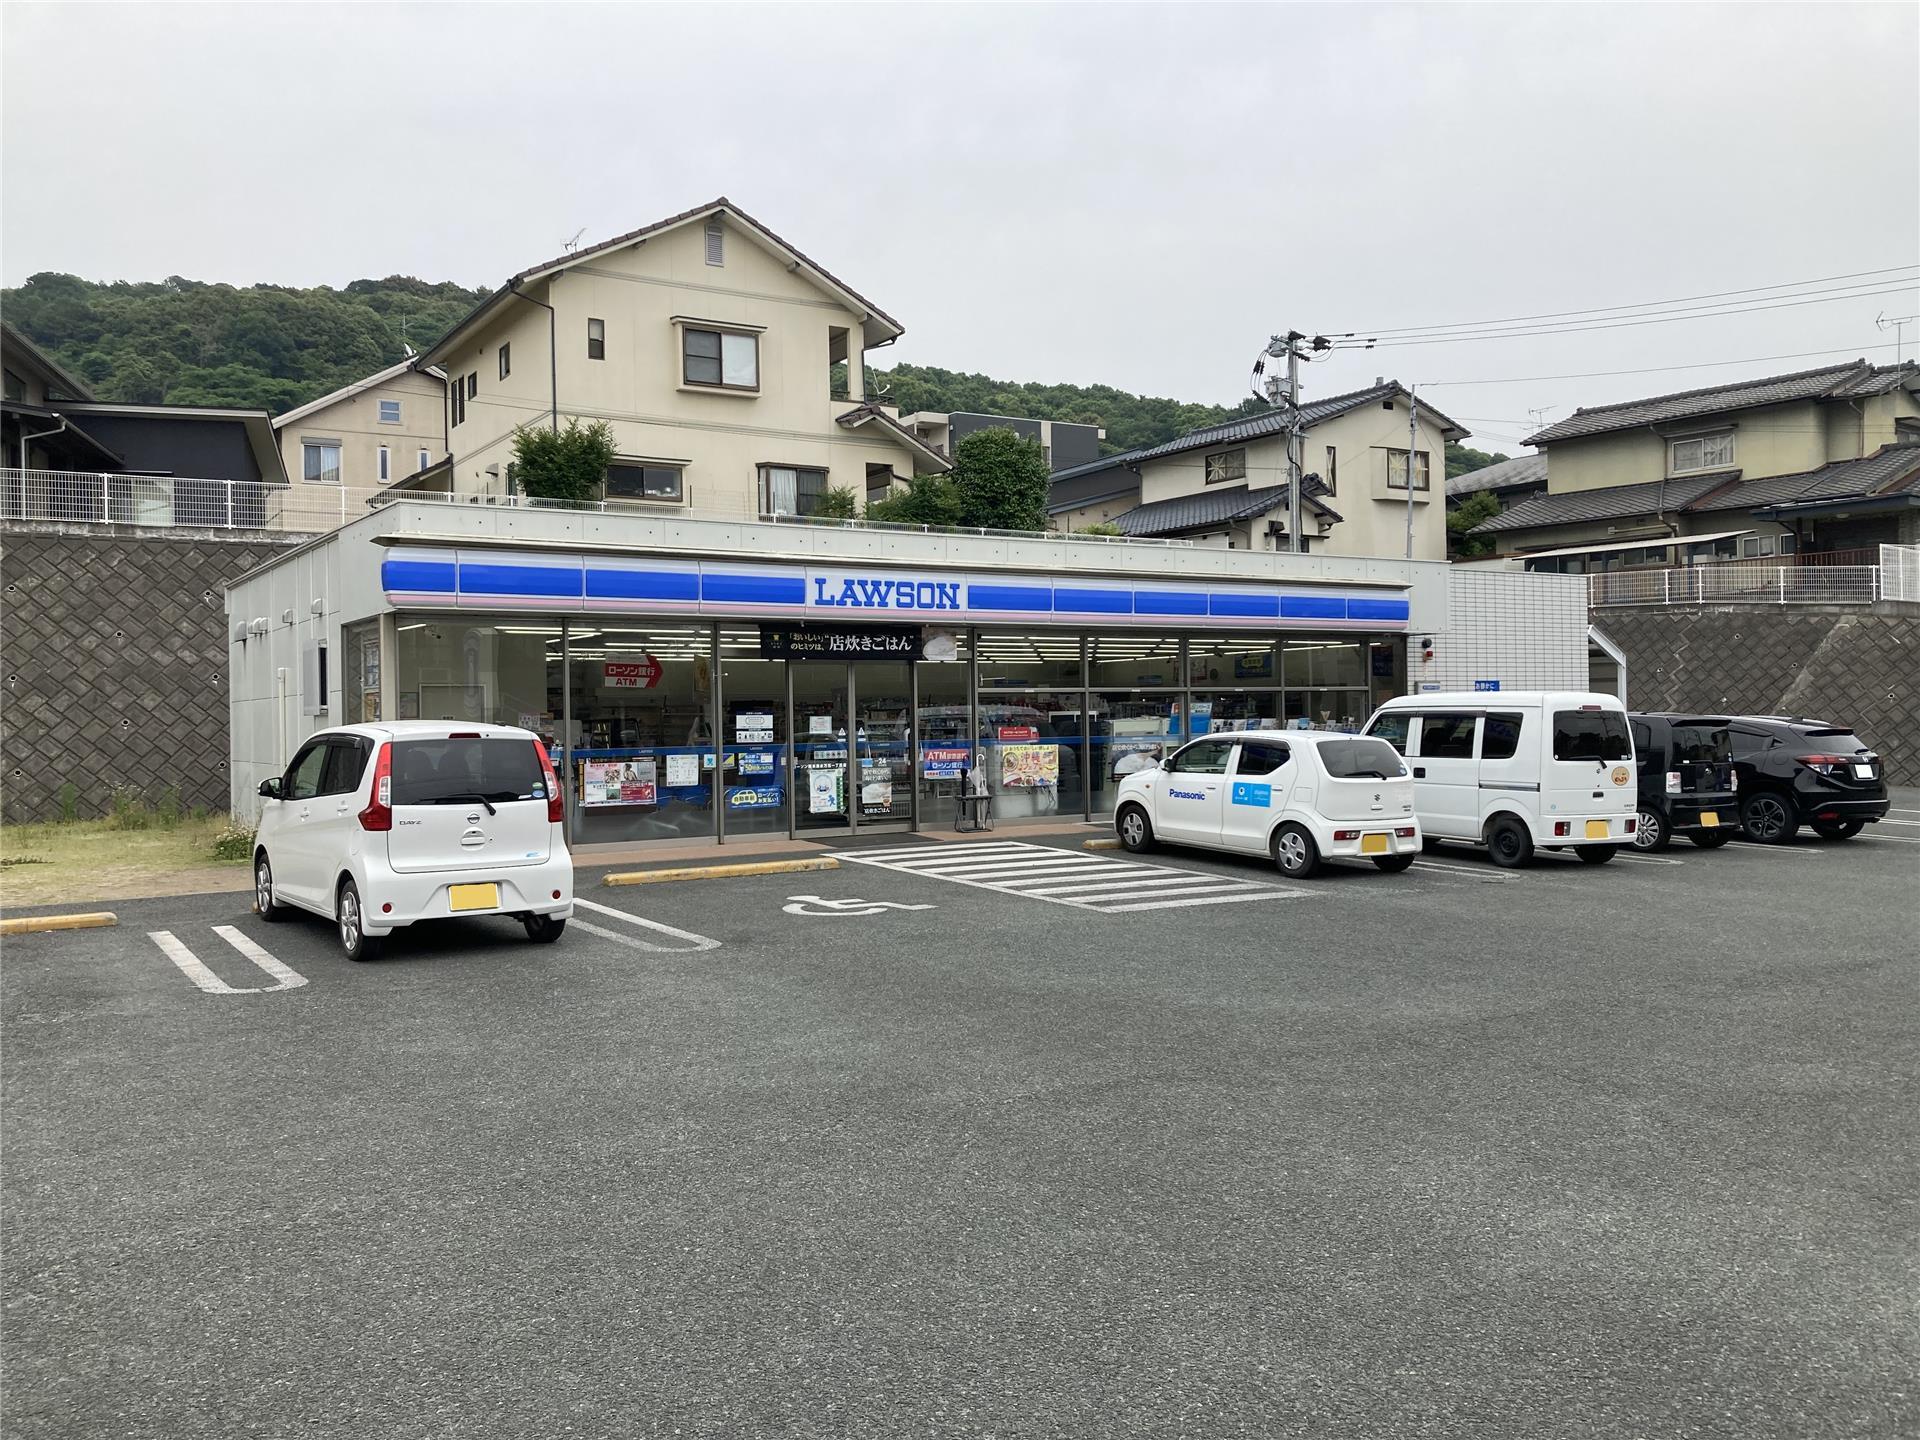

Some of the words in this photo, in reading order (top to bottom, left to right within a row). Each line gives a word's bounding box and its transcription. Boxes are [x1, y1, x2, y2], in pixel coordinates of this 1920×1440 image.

[815, 578, 960, 609] LAWSON
[608, 667, 655, 676] ローソン銀行
[616, 678, 637, 686] ATM
[927, 751, 947, 761] ATM
[1169, 788, 1206, 801] Panasonic
